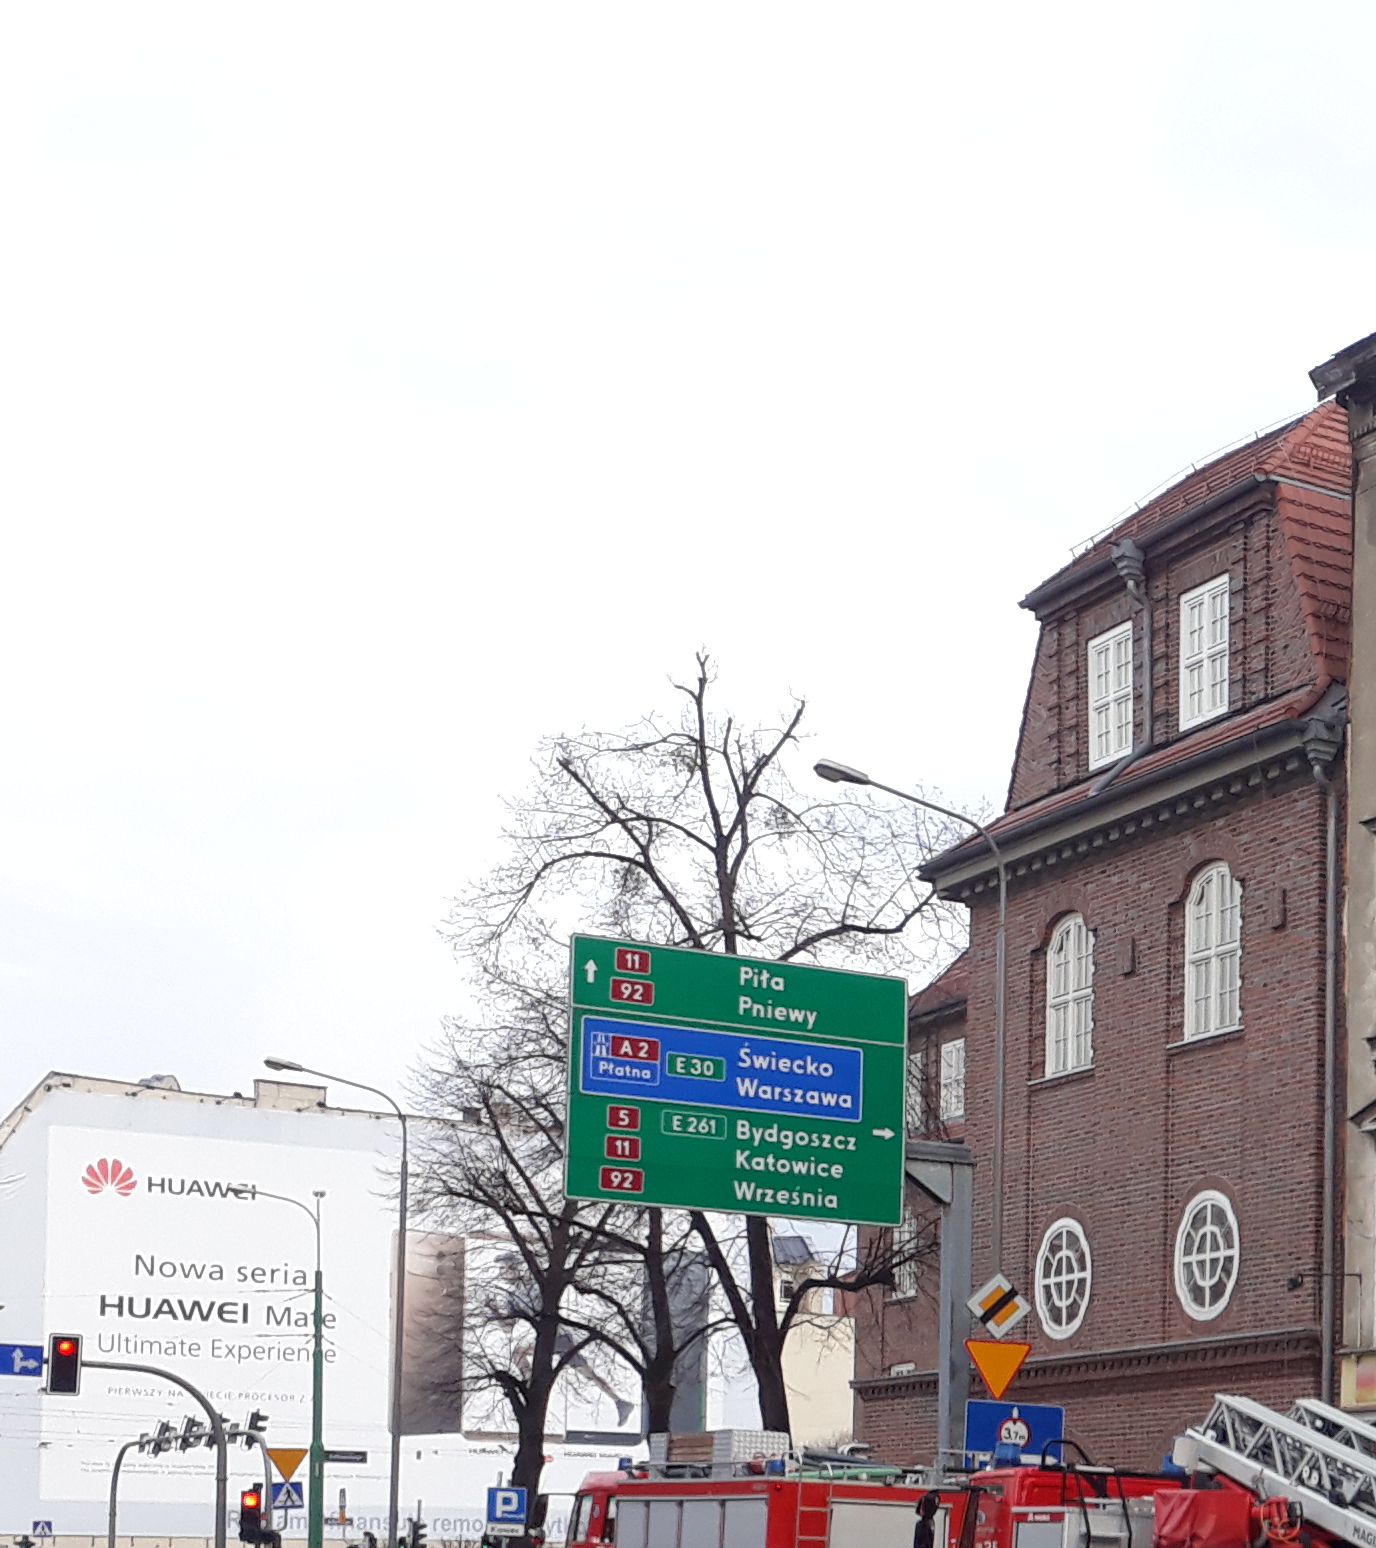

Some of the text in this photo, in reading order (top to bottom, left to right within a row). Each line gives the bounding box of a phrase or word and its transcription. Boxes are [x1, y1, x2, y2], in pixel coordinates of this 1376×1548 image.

[625, 953, 641, 970] 11
[739, 967, 785, 991] Piła
[620, 983, 644, 1001] 92
[738, 995, 818, 1030] Pniewy
[620, 1040, 649, 1058] A 2
[737, 1042, 834, 1077] Świecko
[599, 1061, 651, 1079] Płatna
[675, 1057, 715, 1076] E 30
[736, 1077, 853, 1108] Warszawa
[617, 1109, 630, 1126] 5
[671, 1115, 717, 1134] E 261
[736, 1119, 857, 1151] Bydgoszcz
[614, 1140, 631, 1156] 11
[735, 1149, 844, 1179] Katowice
[609, 1171, 635, 1189] 92
[733, 1180, 839, 1209] Września
[134, 1254, 308, 1286] Nowa seria
[99, 1294, 337, 1330] HUAWEI Mae
[98, 1332, 338, 1365] Ultimate Experiene
[495, 1491, 519, 1519] P
[431, 1517, 484, 1534] remo
